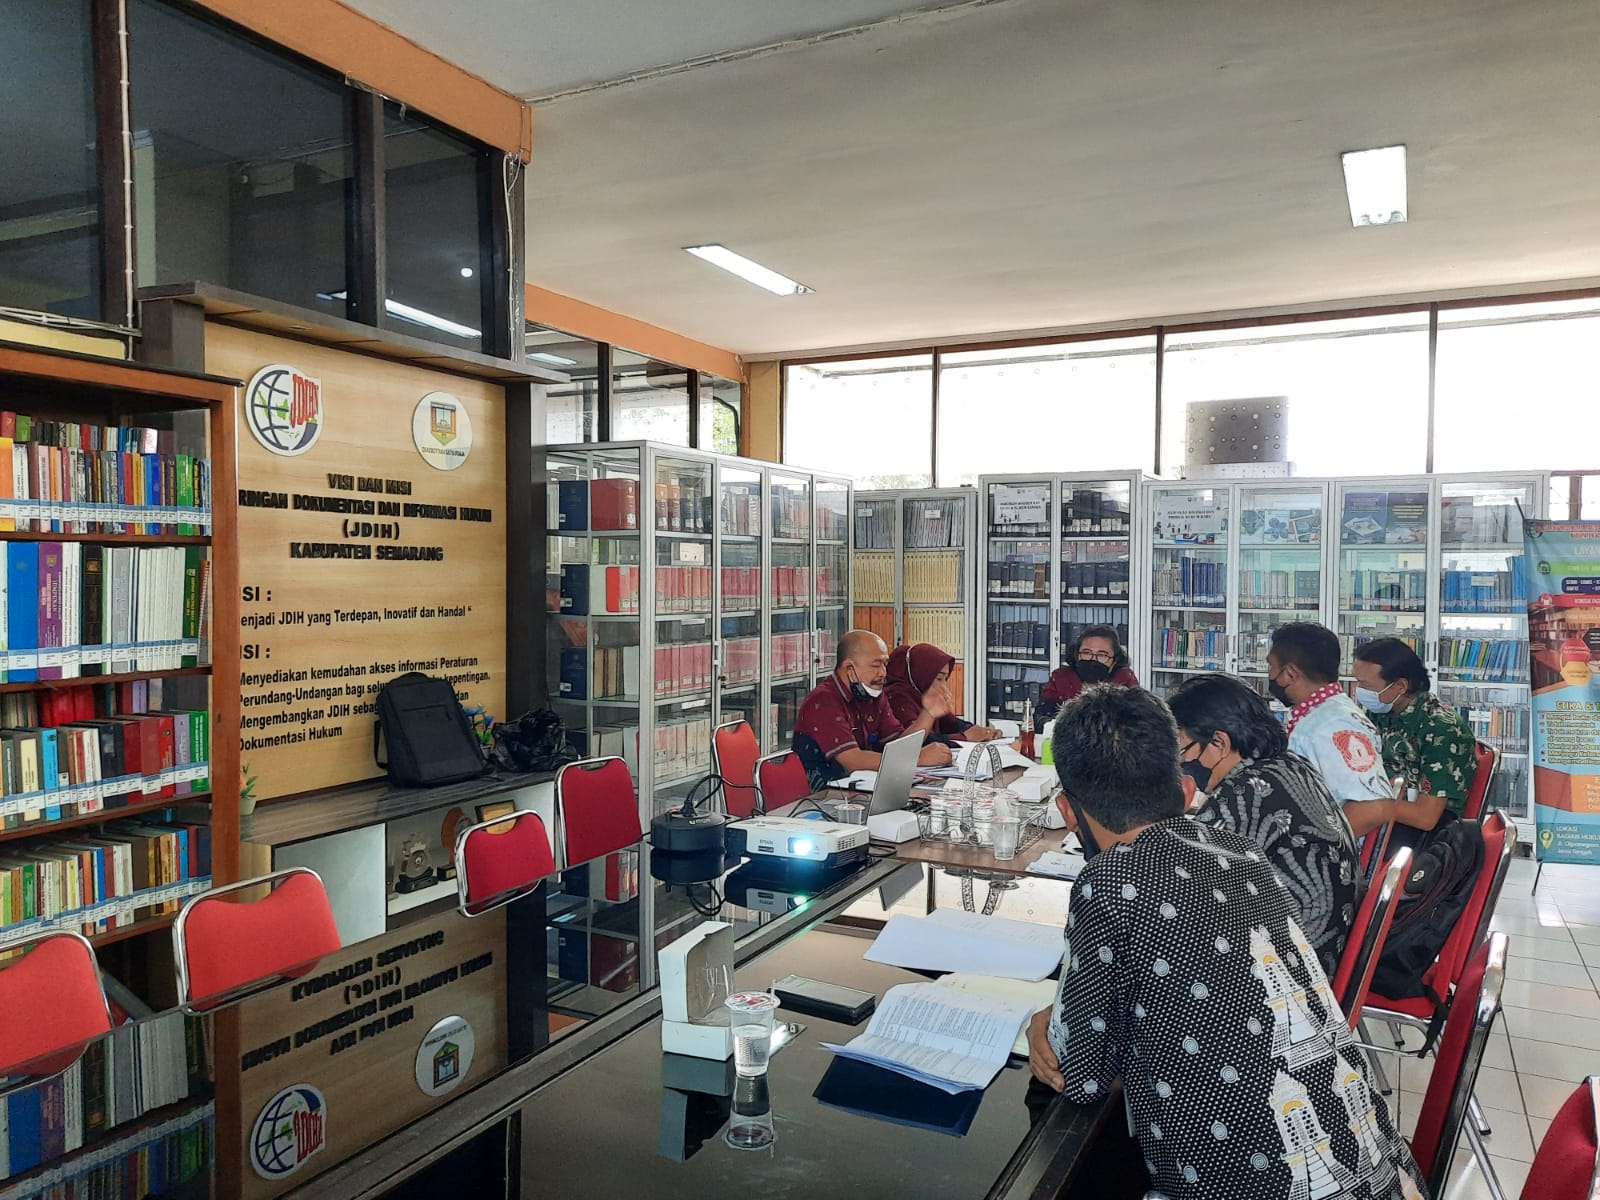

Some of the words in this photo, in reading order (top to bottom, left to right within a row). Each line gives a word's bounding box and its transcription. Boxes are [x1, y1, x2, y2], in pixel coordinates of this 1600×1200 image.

[327, 473, 355, 491] VISI
[357, 476, 383, 493] DAN
[385, 480, 412, 496] MISI
[238, 489, 289, 509] RINGAN
[293, 494, 375, 515] DOKUMENTASI
[378, 501, 401, 516] DAN
[403, 503, 457, 520] INFORMASI
[460, 507, 492, 522] HUKUM
[343, 519, 400, 540] (JDIH)
[290, 542, 372, 559] KABUPATEN
[376, 545, 444, 561] SEMARANG
[239, 586, 260, 602] SI
[240, 612, 275, 629] enjadi
[278, 611, 304, 625] JDIH
[307, 613, 331, 627] yang
[334, 609, 381, 624] Terdepan,
[384, 607, 418, 619] Inovatif
[420, 607, 435, 618] dan
[438, 605, 466, 617] Handal
[239, 644, 260, 660] SI
[311, 664, 366, 680] kemudahan
[369, 661, 396, 675] akses
[398, 659, 438, 673] informasi
[440, 656, 478, 669] Peraturan
[345, 683, 365, 698] bagi
[327, 704, 350, 719] JDIH
[240, 729, 306, 751] Dokumentasi
[308, 725, 342, 741] Hukum
